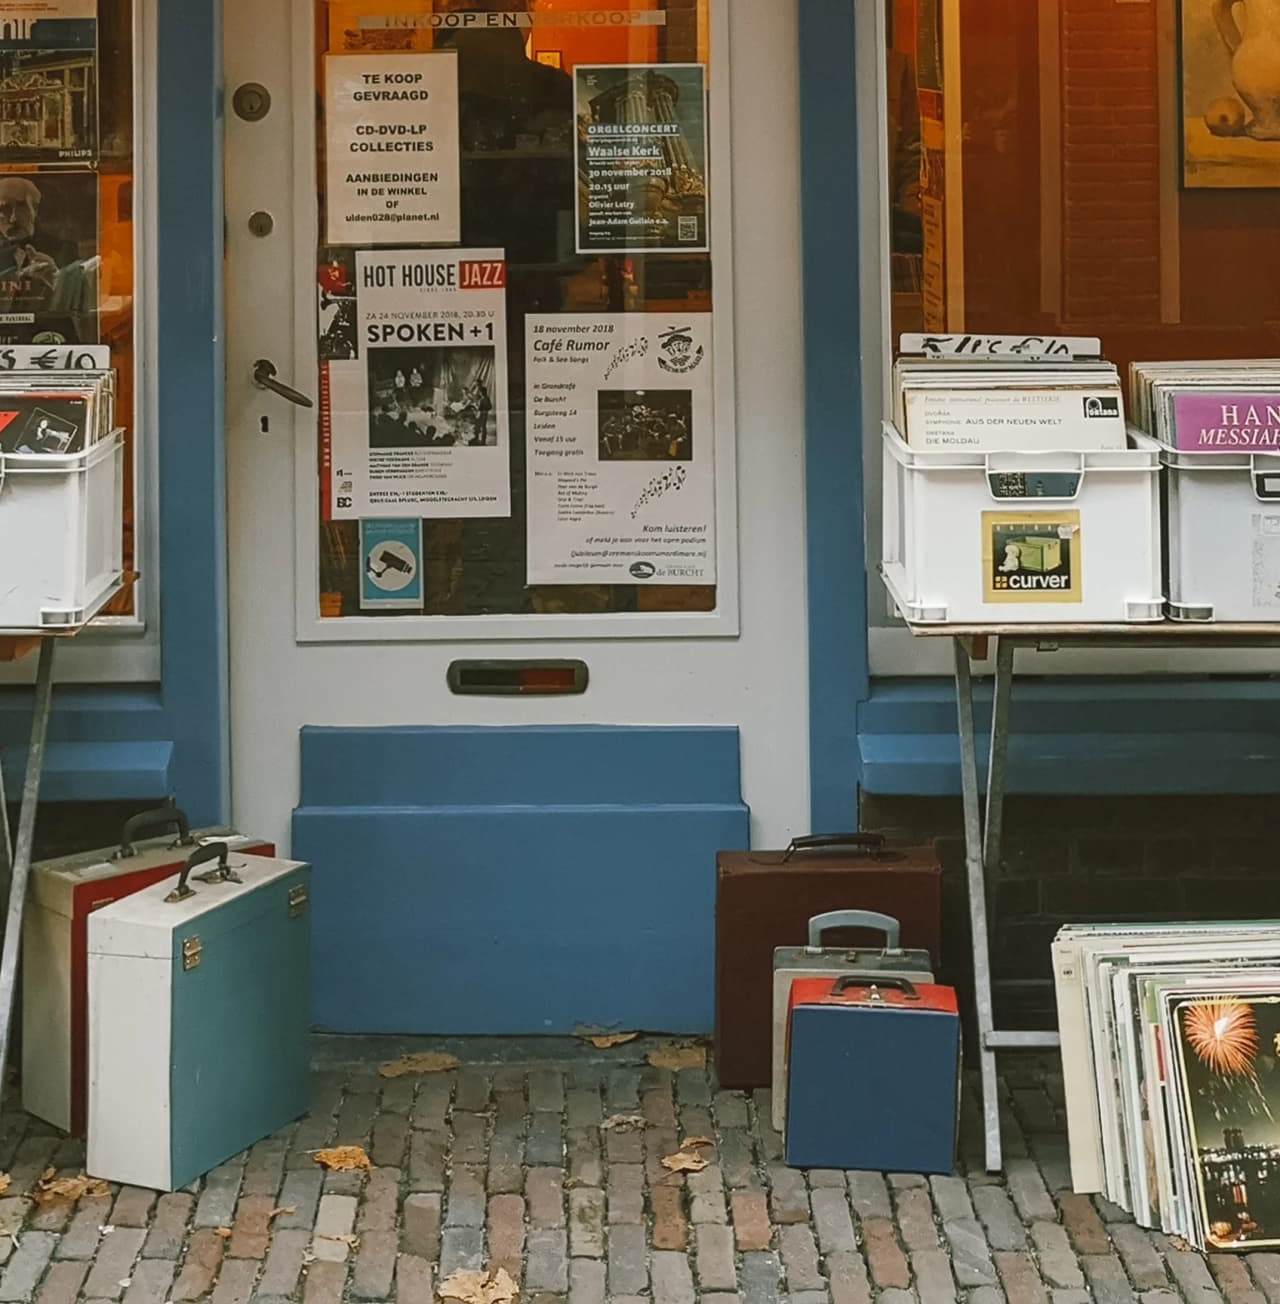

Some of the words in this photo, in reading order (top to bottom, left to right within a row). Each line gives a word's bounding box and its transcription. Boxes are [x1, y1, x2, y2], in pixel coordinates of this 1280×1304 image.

[487, 12, 518, 27] EN
[362, 74, 380, 84] TE
[385, 74, 422, 84] KOOP
[353, 91, 428, 101] GEVRAAGD
[356, 125, 428, 136] CD-DVD-LP
[588, 124, 678, 134] ORGELCONCERT
[350, 142, 434, 152] COLLECTIES
[588, 145, 630, 156] Waalse
[631, 145, 661, 156] Kerk
[601, 167, 648, 177] november
[346, 173, 439, 183] AANBIEDINGEN
[357, 188, 369, 197] IN
[371, 188, 385, 196] DE
[387, 187, 428, 196] WINKEL
[385, 200, 399, 209] OF
[363, 265, 396, 288] HOT
[402, 264, 457, 287] HOUSE
[462, 263, 503, 286] JAZZ
[391, 311, 438, 319] NOVEMBER
[367, 323, 464, 343] SPOKEN
[545, 325, 590, 334] november
[592, 325, 614, 333] 2018
[533, 339, 563, 353] Café
[566, 339, 610, 352] Rumor
[925, 437, 940, 445] DIE
[942, 437, 981, 445] MOLDAU
[642, 525, 663, 533] Kom
[664, 524, 707, 533] luisteren!
[1008, 574, 1069, 589] curver
